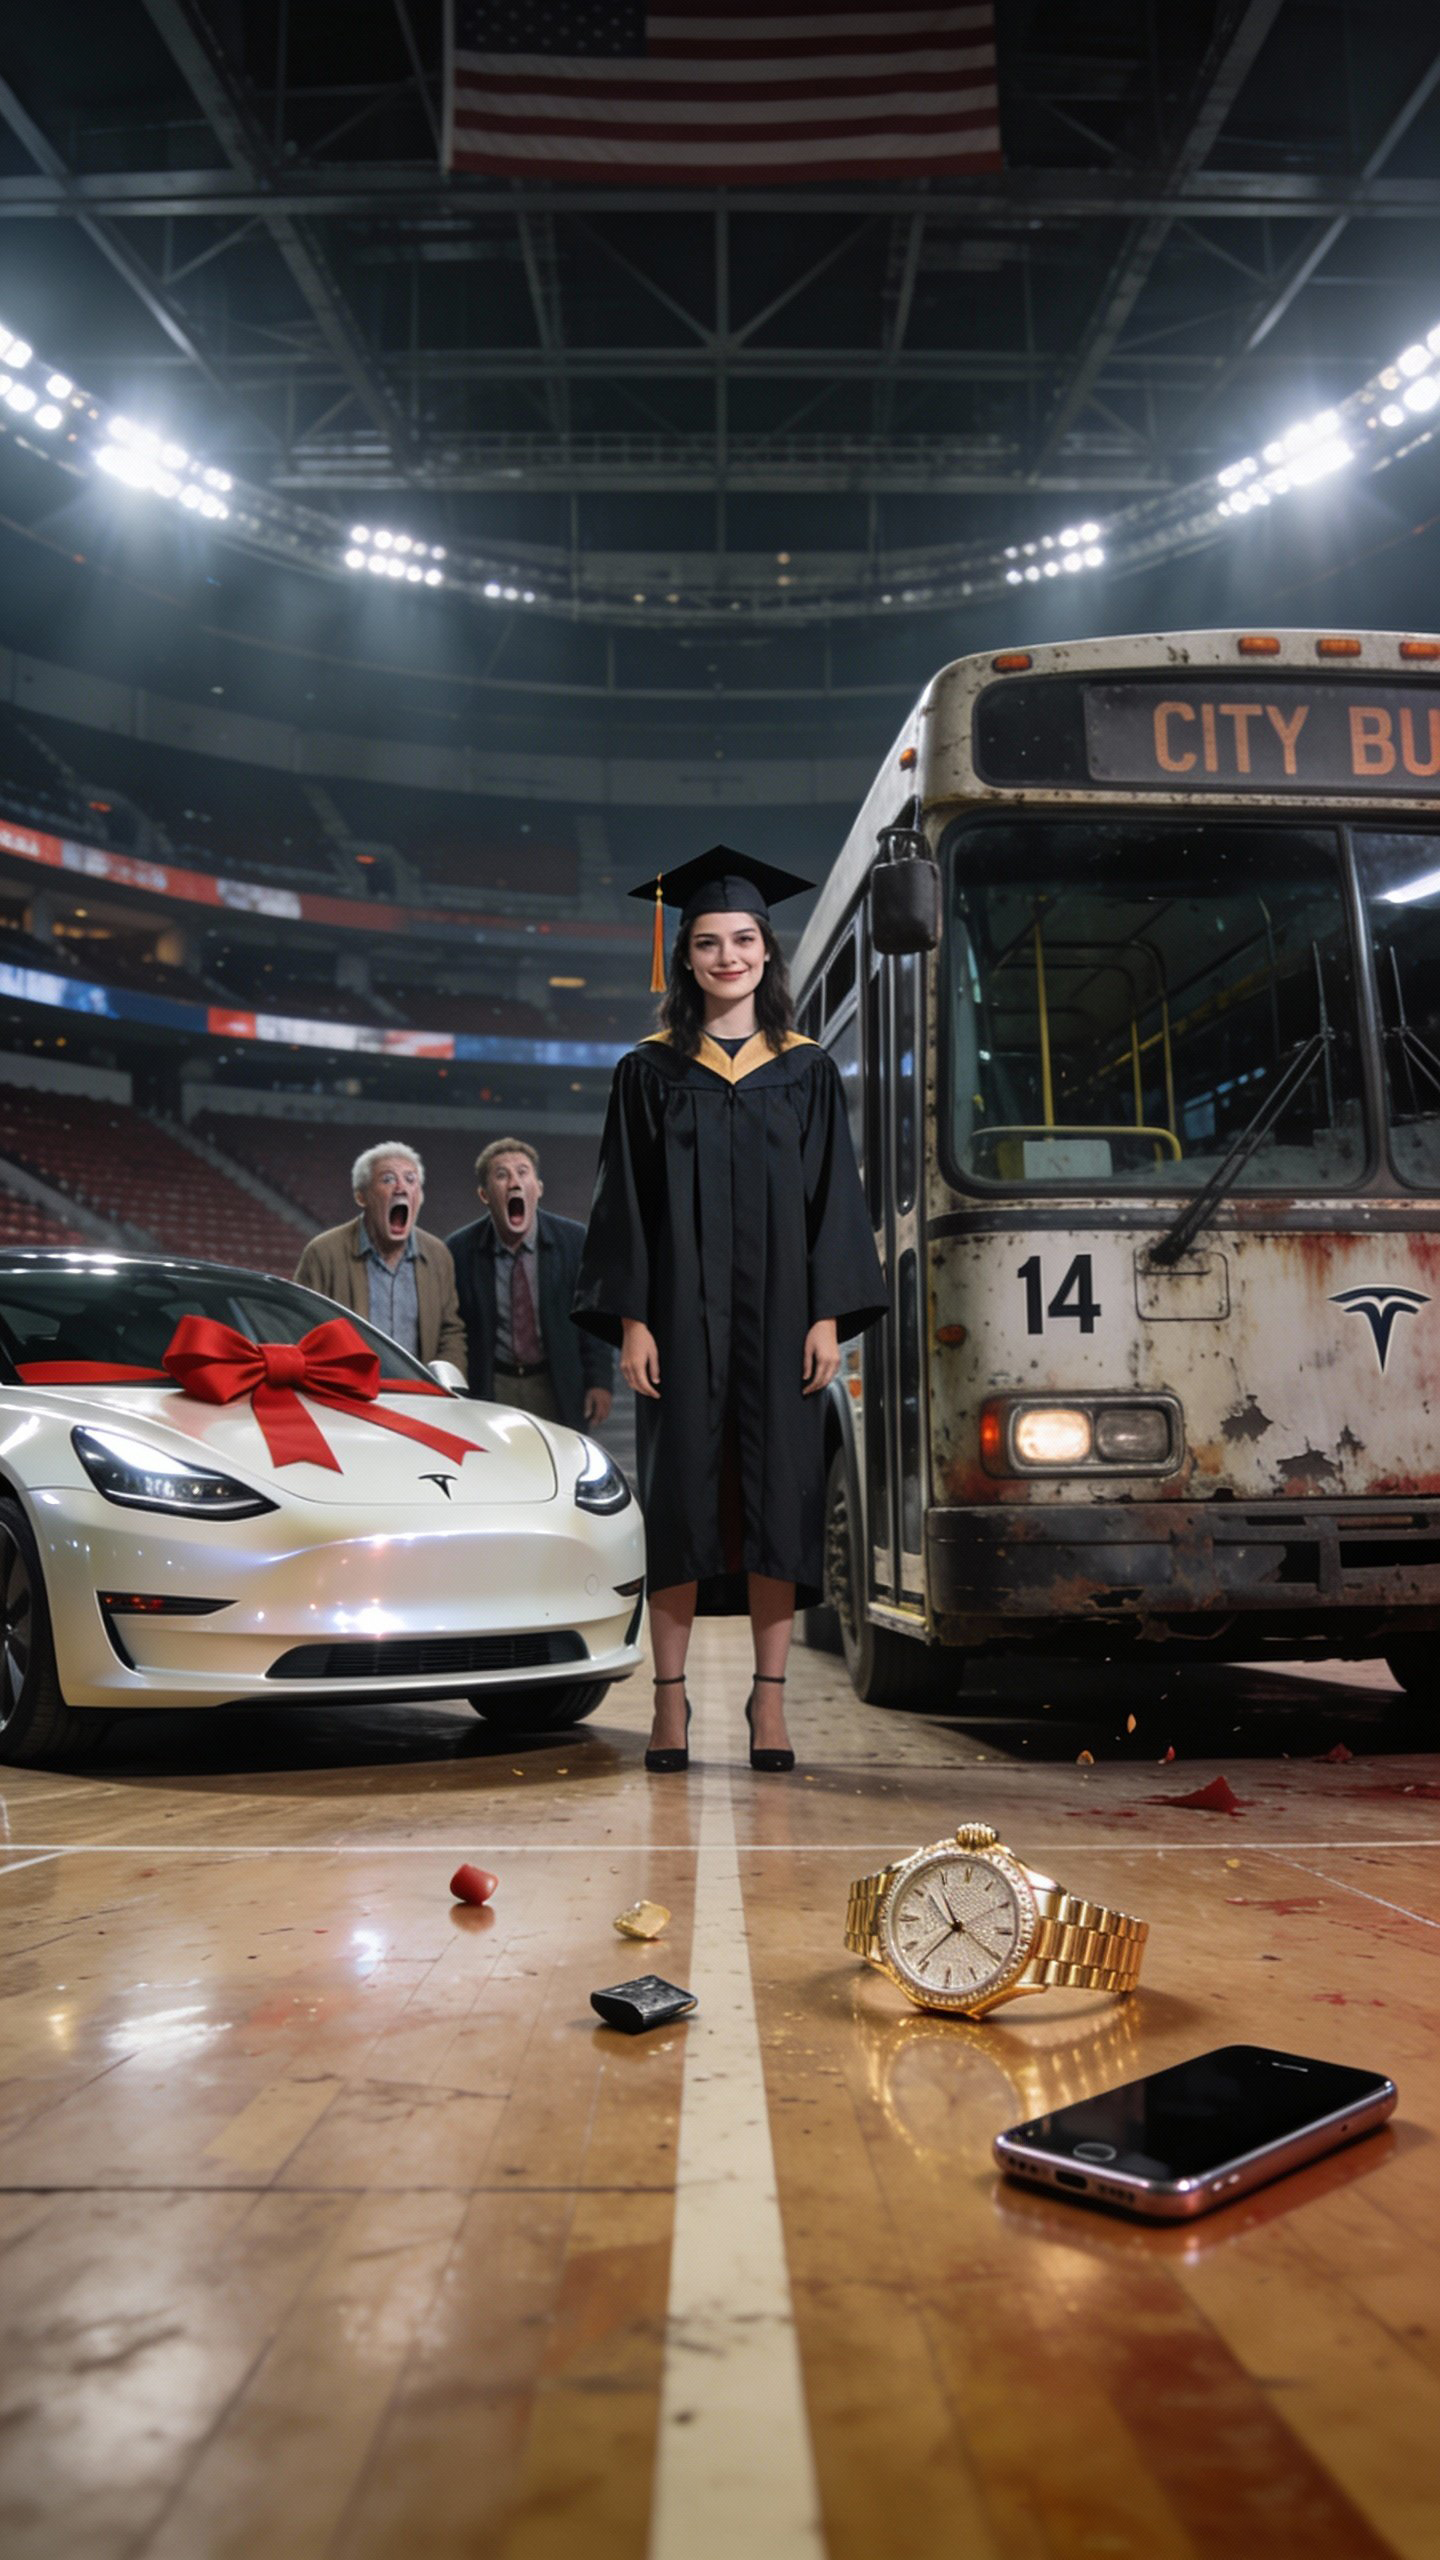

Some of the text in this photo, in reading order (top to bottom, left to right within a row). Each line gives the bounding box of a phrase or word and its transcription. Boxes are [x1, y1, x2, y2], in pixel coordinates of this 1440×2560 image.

[1153, 701, 1440, 777] CITY BU
[1017, 1254, 1102, 1335] 14
